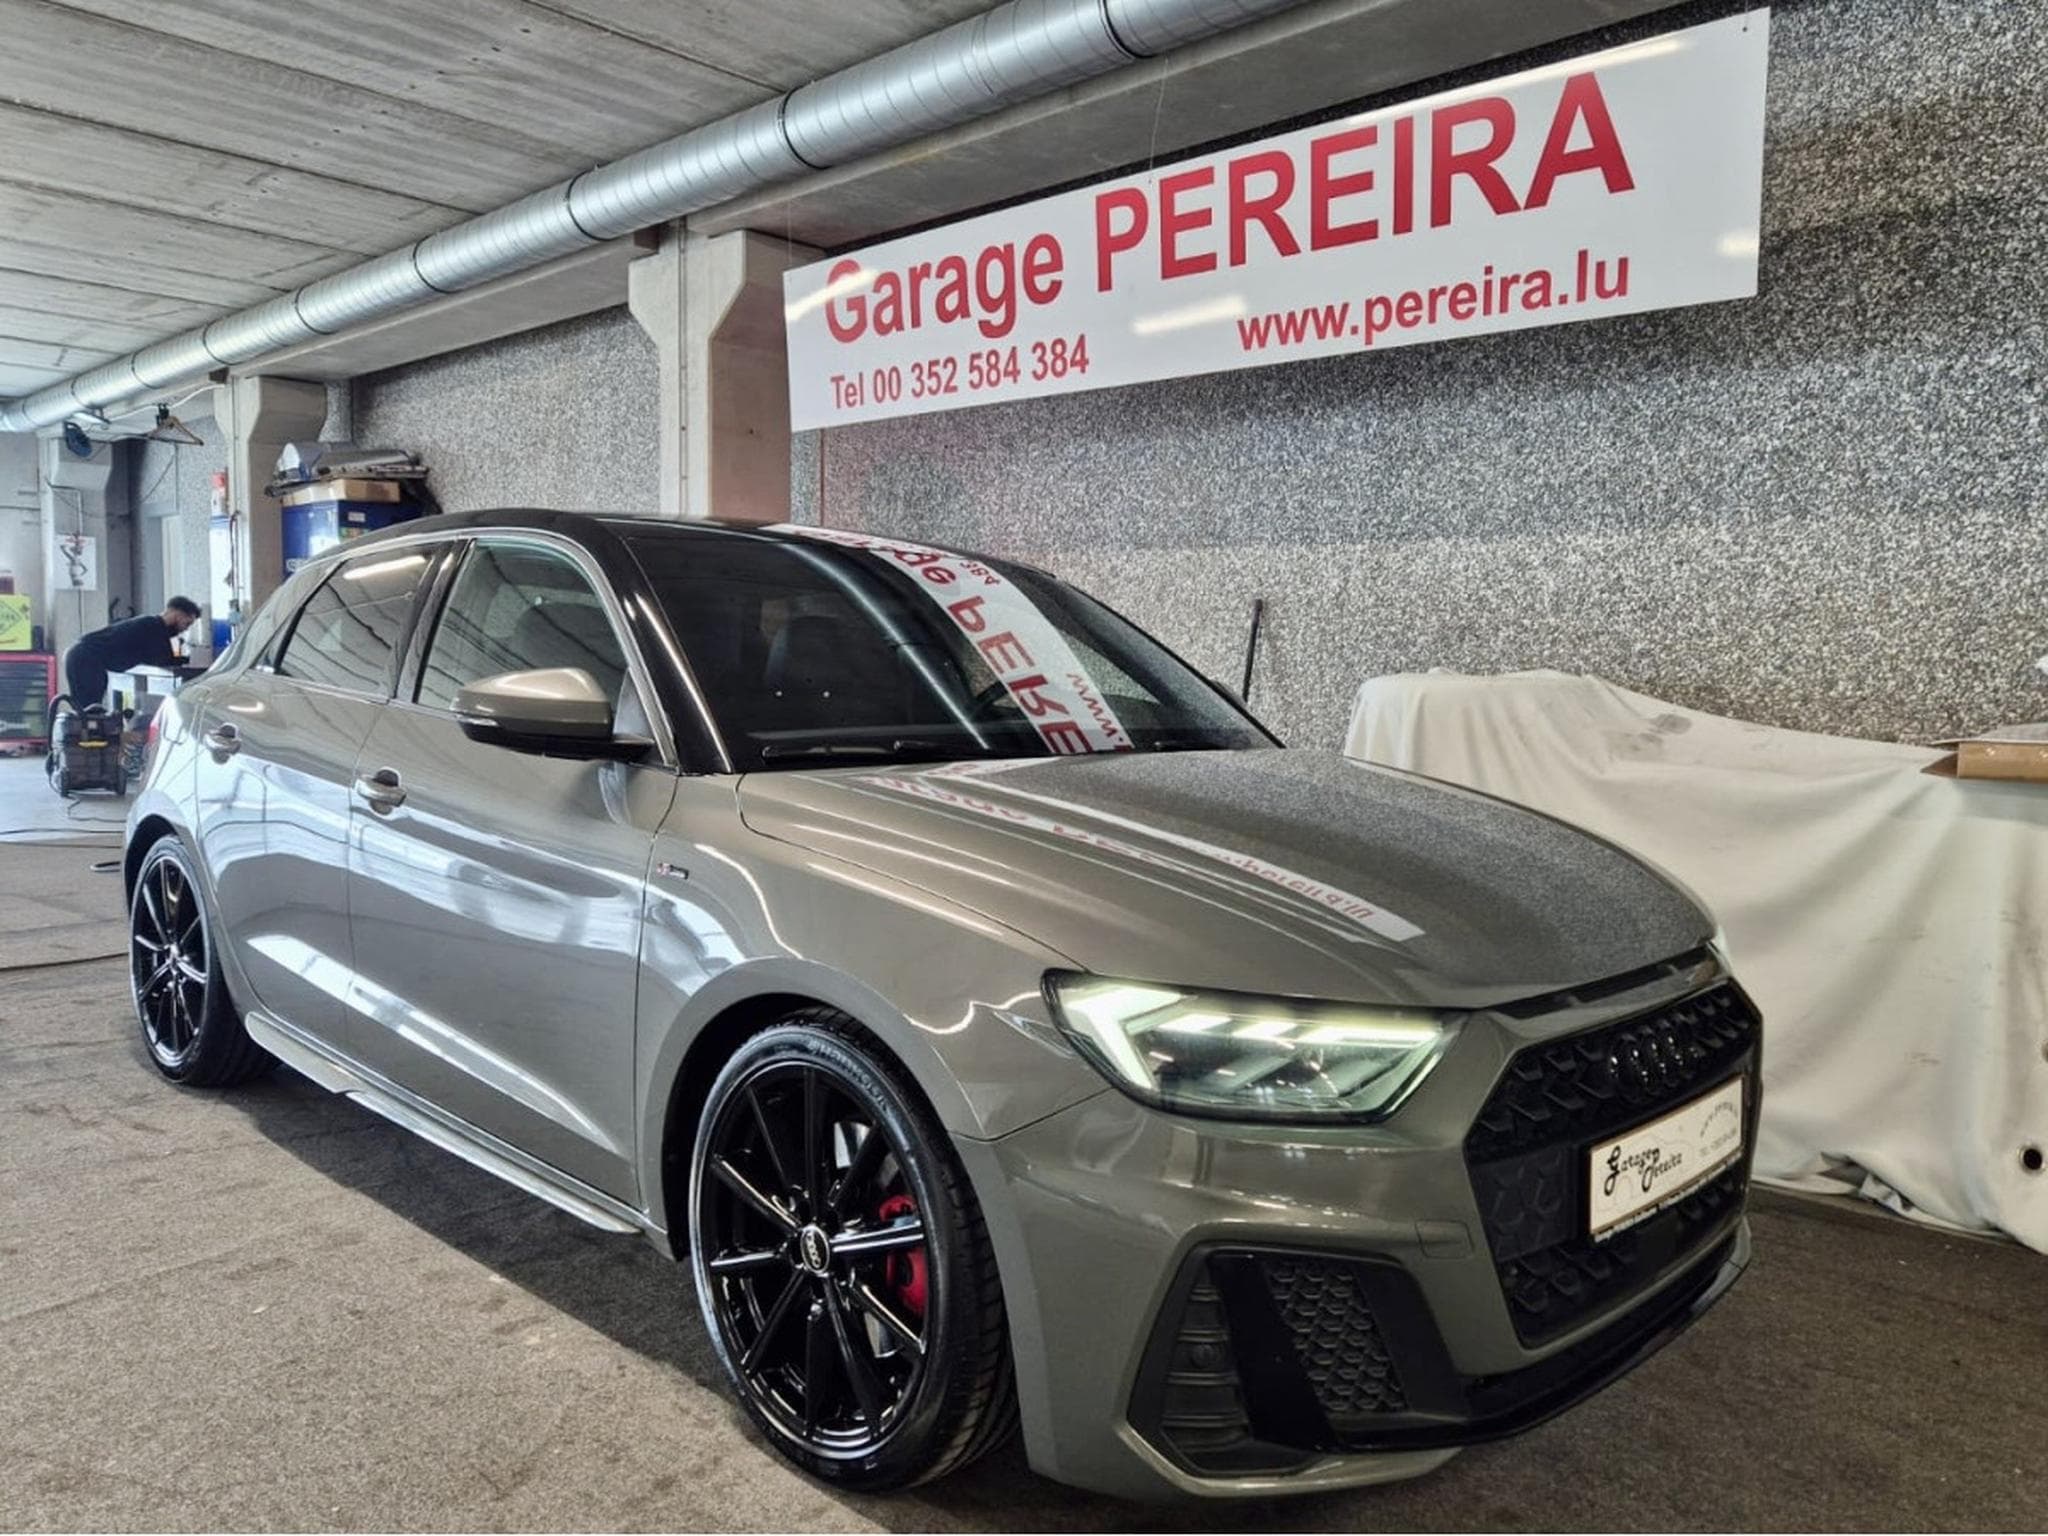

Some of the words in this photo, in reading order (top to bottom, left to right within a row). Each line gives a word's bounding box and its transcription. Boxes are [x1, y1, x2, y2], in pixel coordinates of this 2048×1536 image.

[826, 232, 1065, 344] Garage
[1094, 71, 1635, 294] PEREIRA
[1237, 249, 1631, 353] www.pereira.lu
[830, 372, 866, 410] Tel
[872, 367, 903, 403] 00
[910, 356, 959, 396] 352
[968, 346, 1021, 389] 584
[1031, 334, 1090, 382] 384
